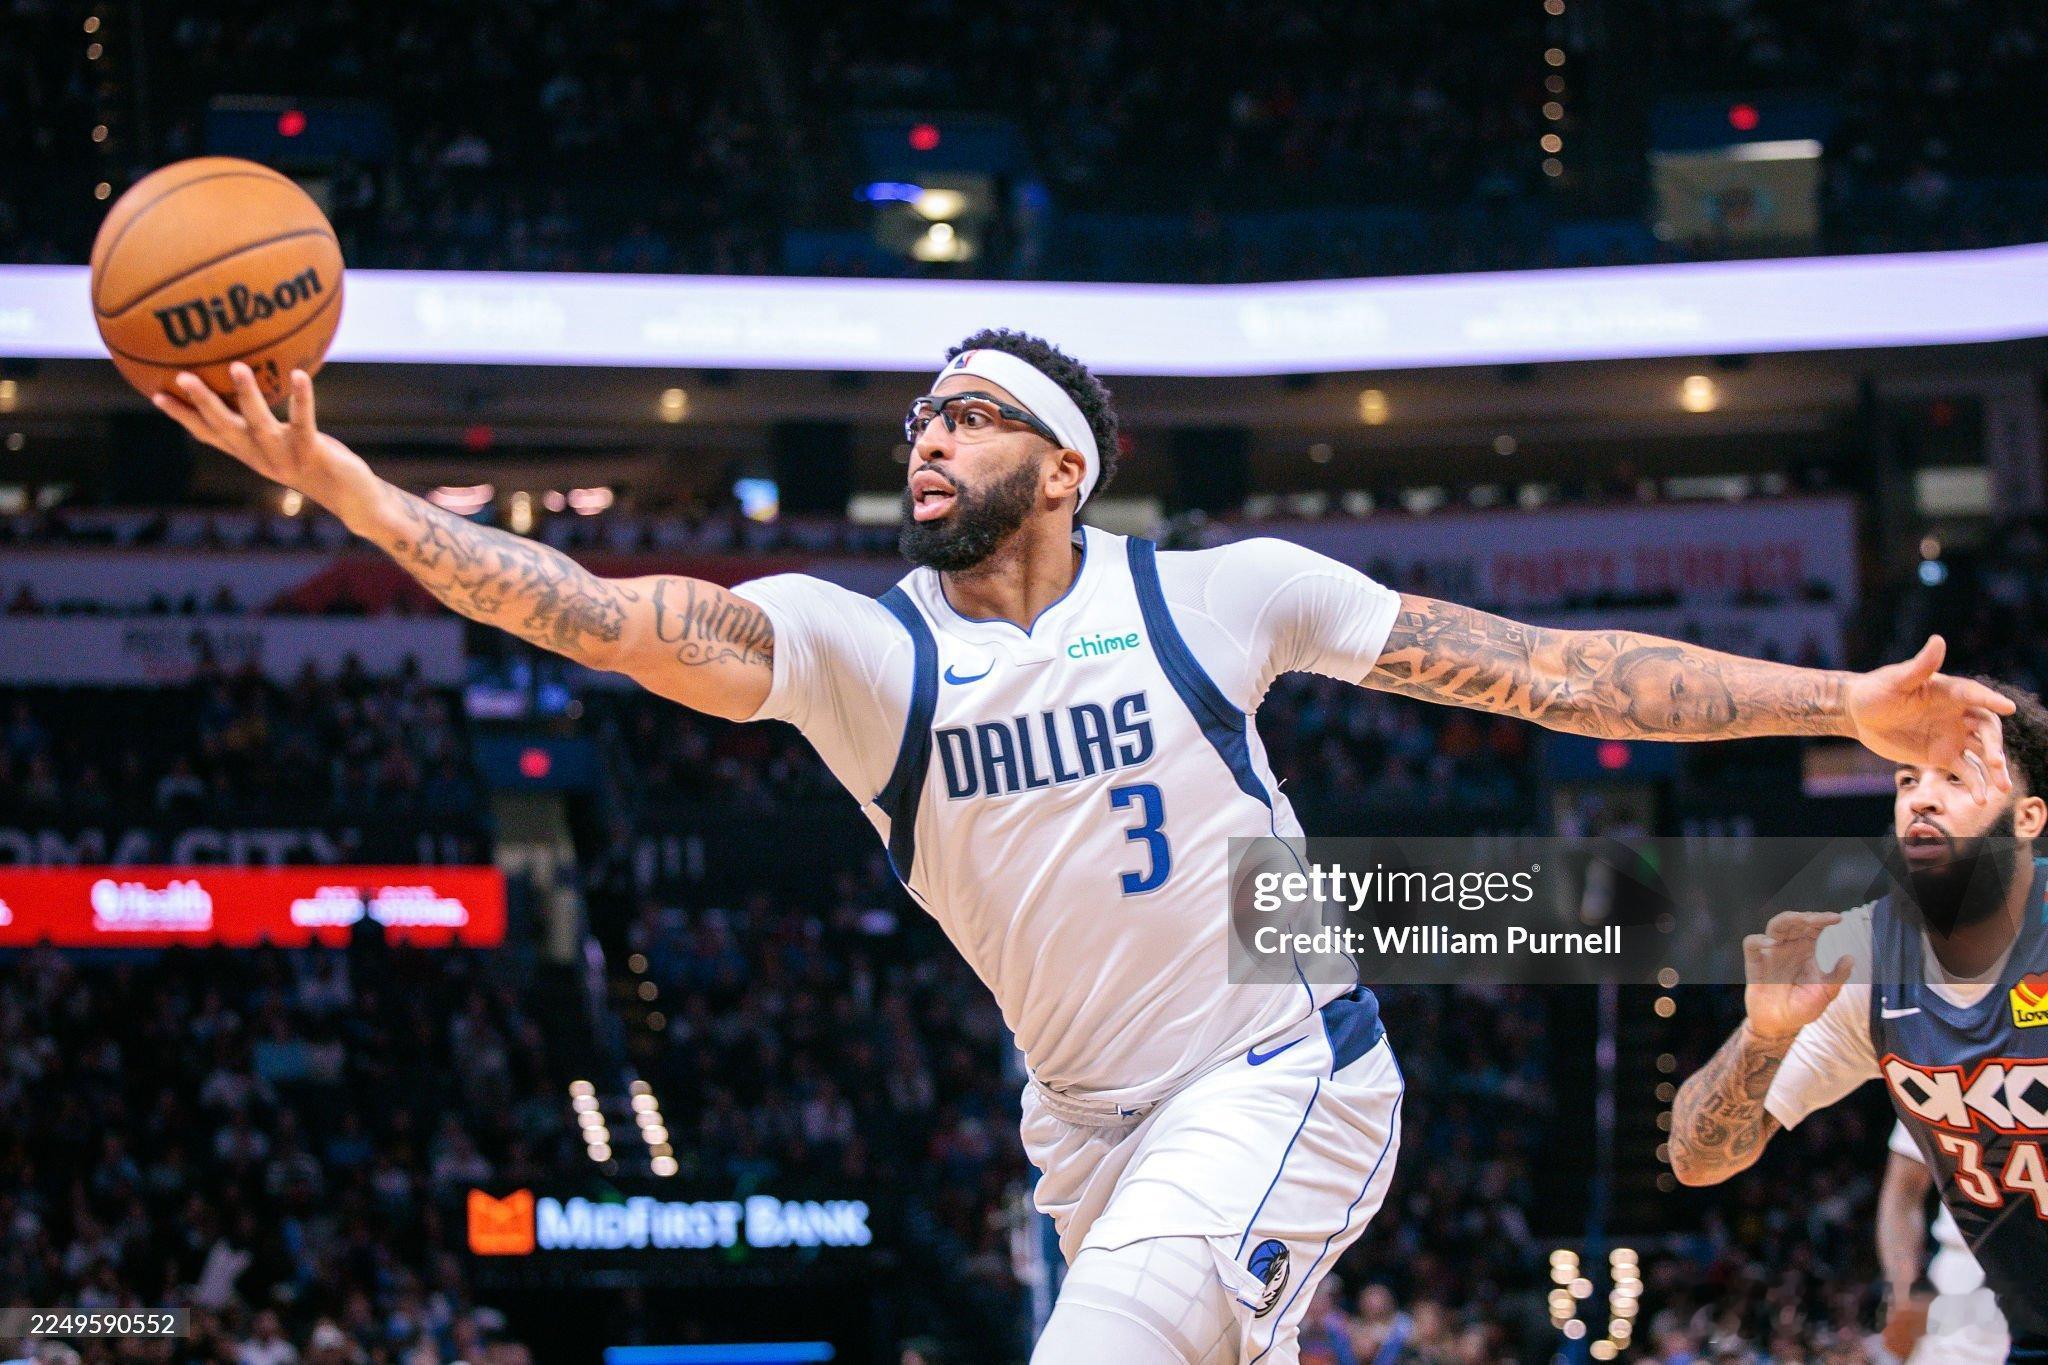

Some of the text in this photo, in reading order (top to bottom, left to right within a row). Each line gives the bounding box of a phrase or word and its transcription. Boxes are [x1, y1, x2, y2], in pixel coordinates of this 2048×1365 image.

[154, 266, 323, 348] Wilson
[1066, 630, 1141, 659] chime
[934, 690, 1155, 801] DALLAS
[1107, 782, 1173, 897] 3
[1934, 1131, 2048, 1221] 34
